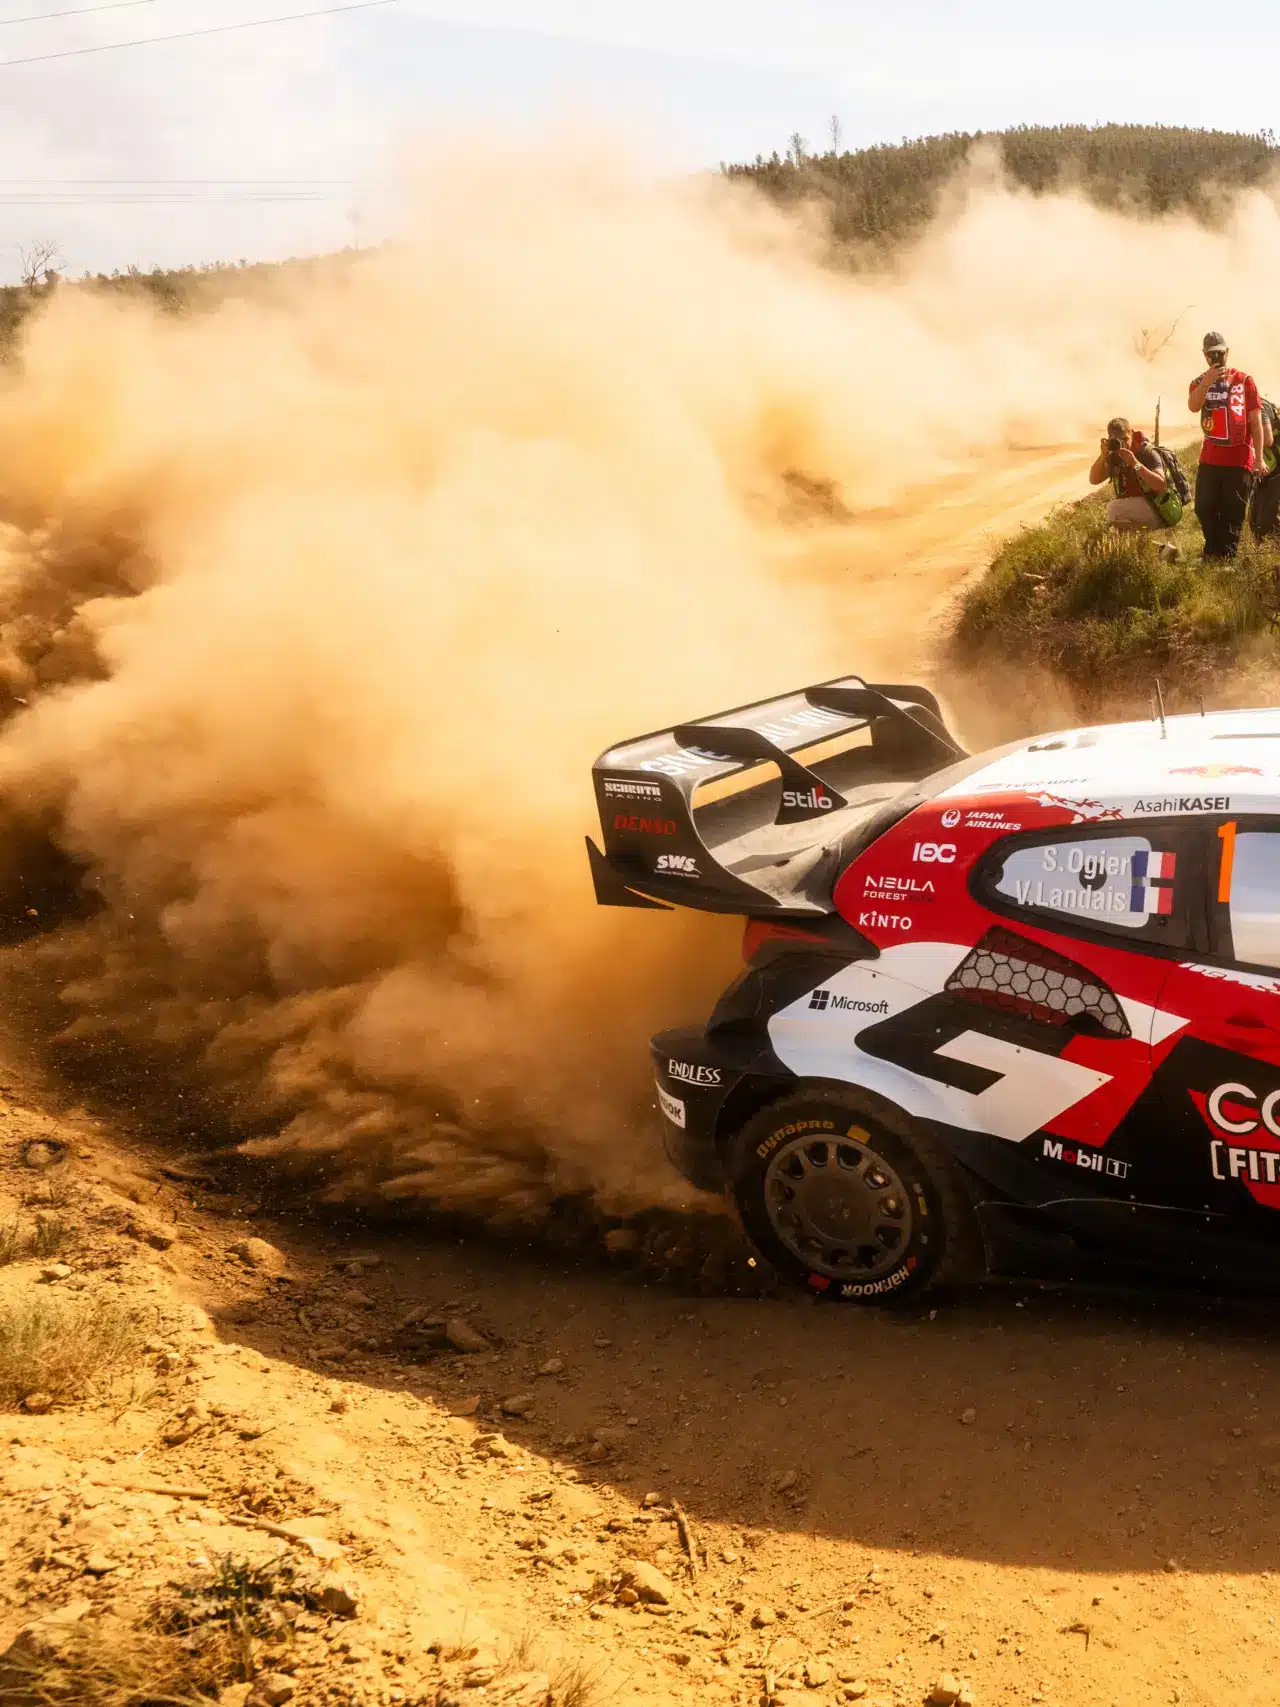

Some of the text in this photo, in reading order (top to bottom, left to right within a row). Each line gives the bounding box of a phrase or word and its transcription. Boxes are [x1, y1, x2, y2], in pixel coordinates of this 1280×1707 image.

[604, 783, 661, 796] SCHROTH
[605, 793, 662, 802] RACING
[782, 785, 833, 809] Stilo
[613, 814, 677, 835] DENSO
[965, 811, 1004, 820] JAPAN
[964, 821, 1022, 831] AIRLINES
[657, 854, 697, 872] SWS
[1217, 821, 1237, 903] 1
[863, 890, 907, 901] FOREST
[830, 995, 889, 1014] Microsoft
[668, 1059, 721, 1084] ENDLESS
[1043, 1138, 1103, 1172] Mobil
